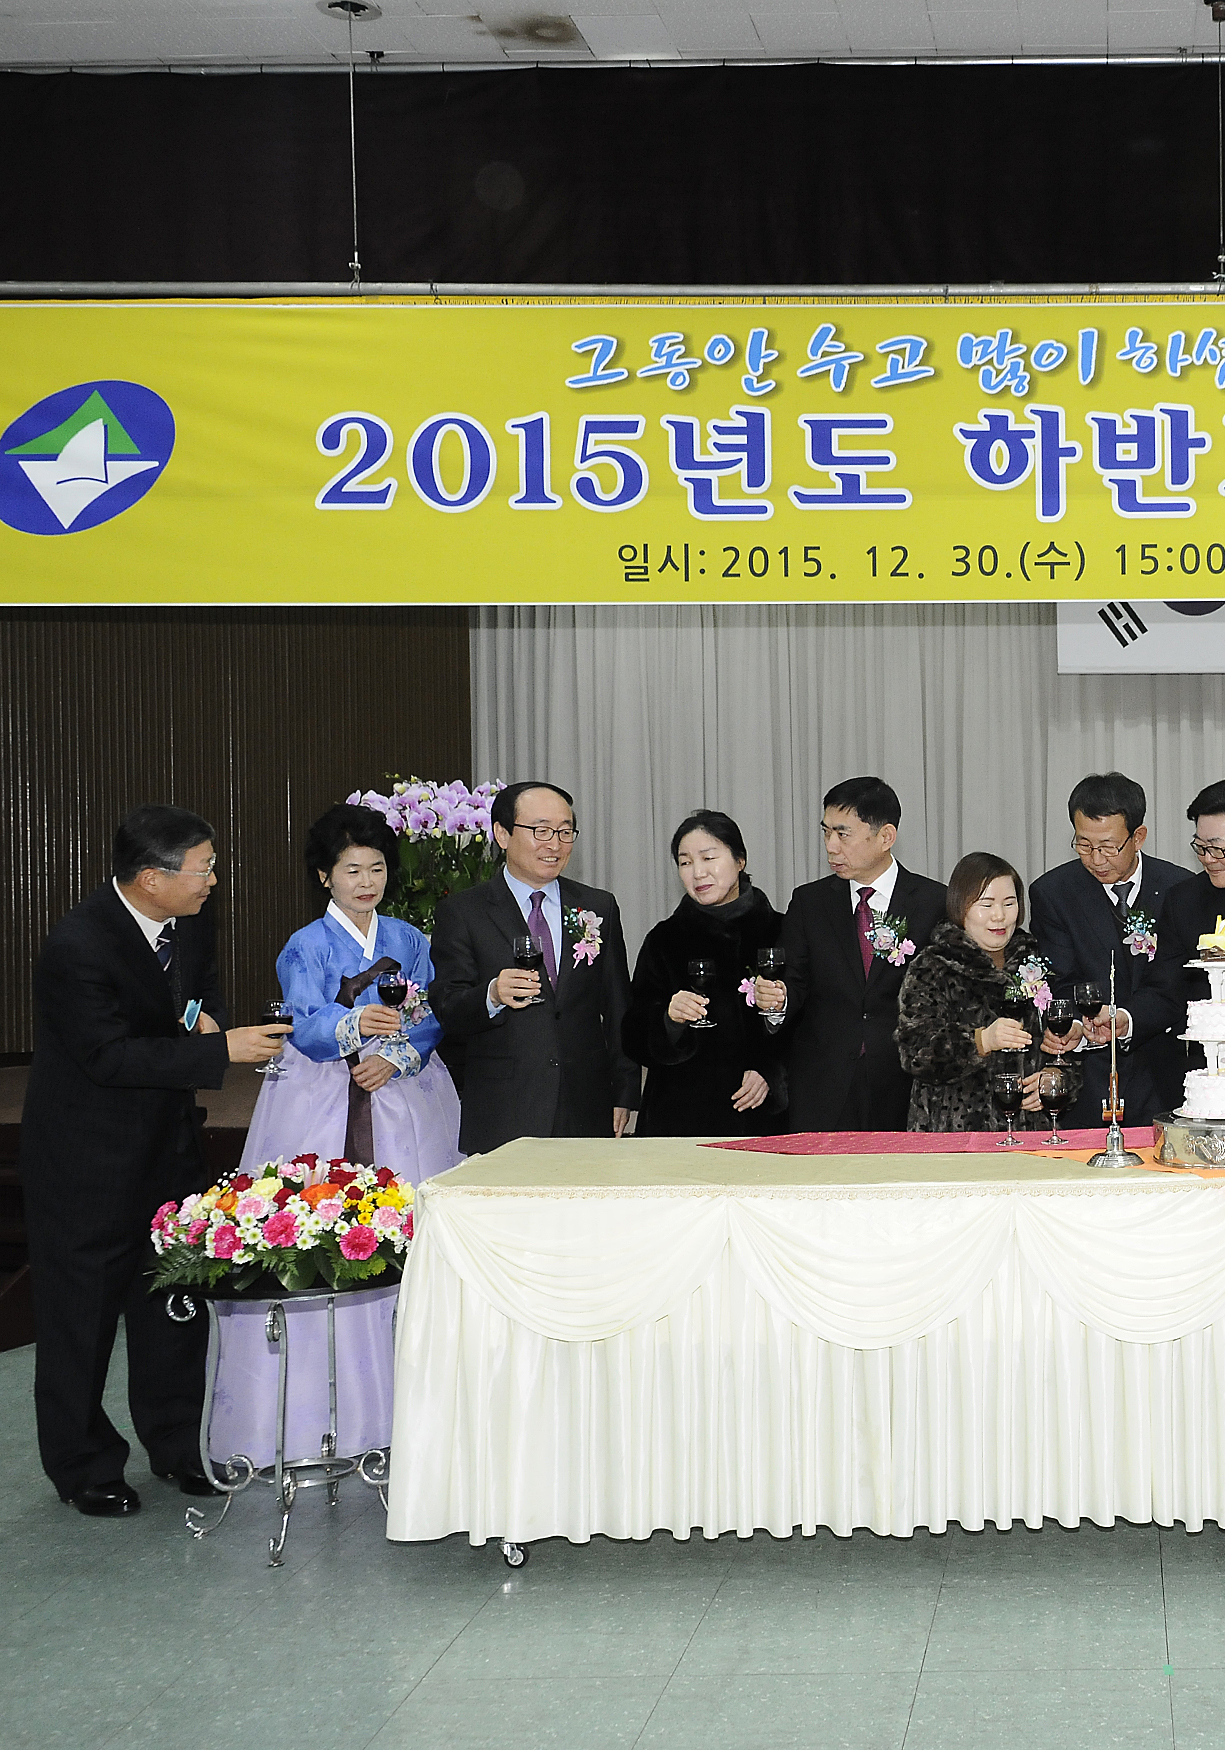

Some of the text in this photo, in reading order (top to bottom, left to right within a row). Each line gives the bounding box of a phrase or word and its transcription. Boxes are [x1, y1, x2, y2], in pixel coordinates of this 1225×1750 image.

[564, 326, 782, 397] 그동안
[796, 323, 935, 392] 수고
[956, 327, 1098, 397] 많이
[316, 406, 911, 519] 2015년도
[616, 542, 707, 583] 일시:
[720, 545, 838, 581] 2015.
[865, 544, 926, 580] 12.
[950, 540, 1087, 583] 30.(수)
